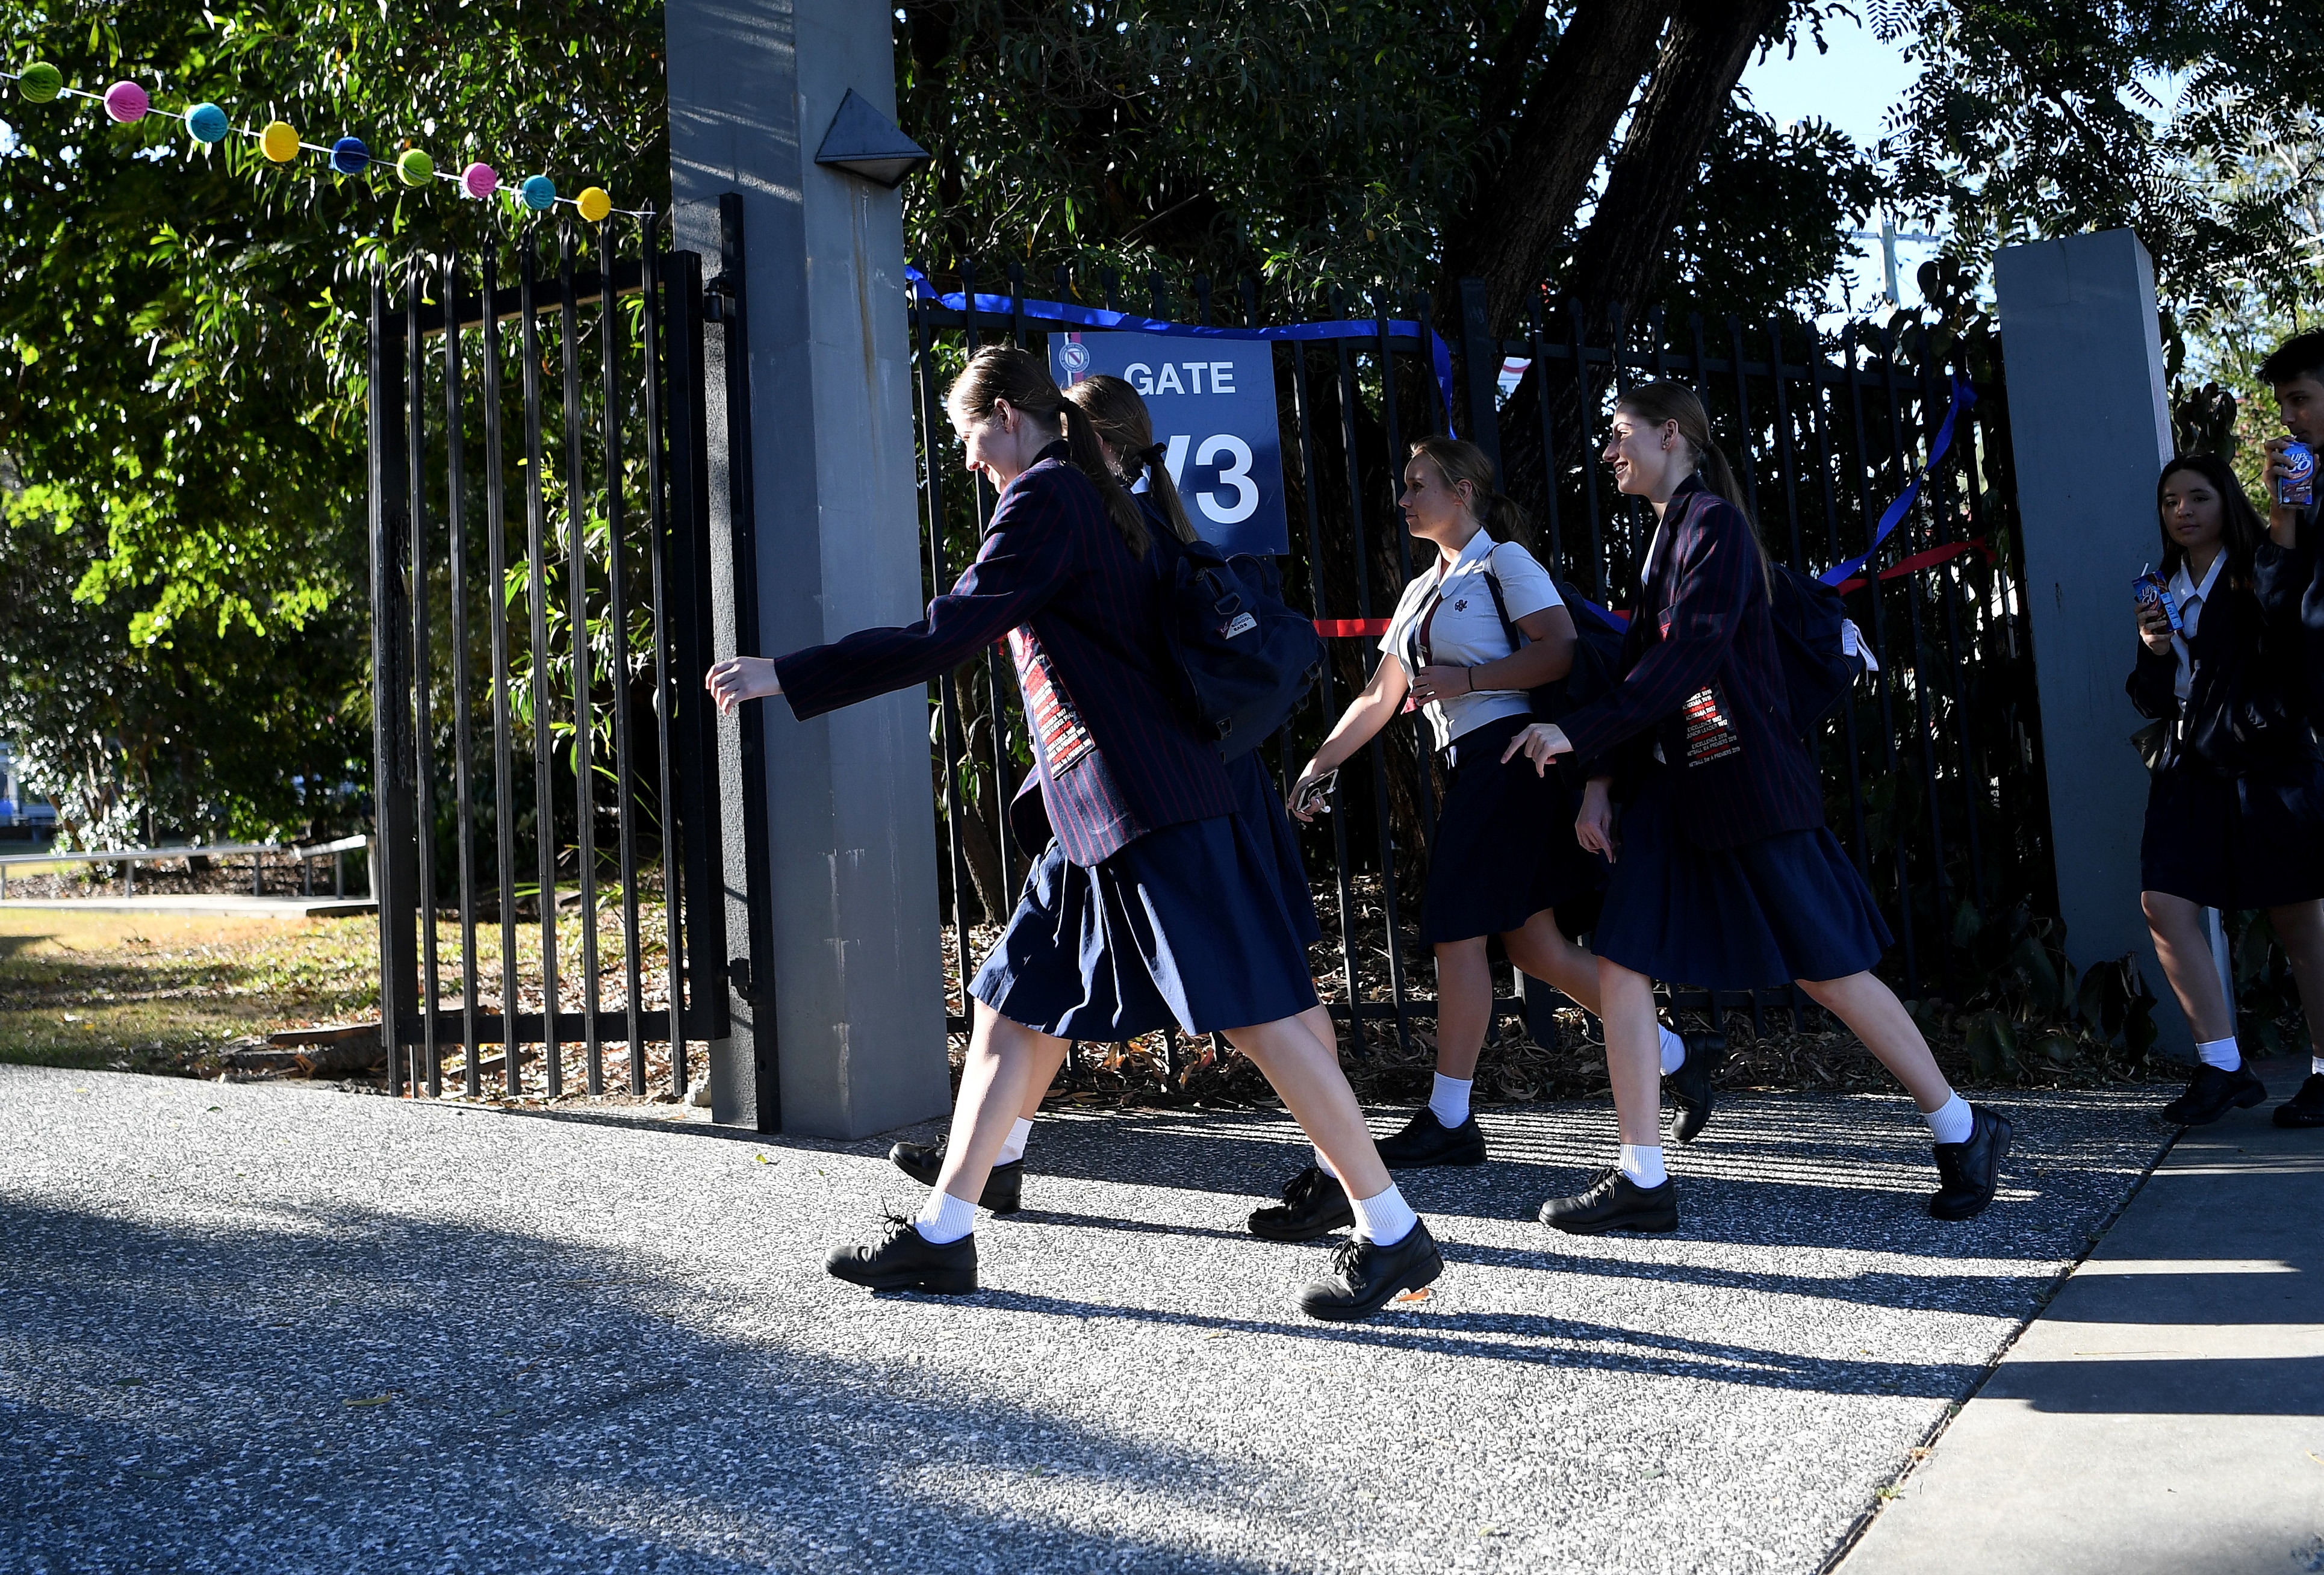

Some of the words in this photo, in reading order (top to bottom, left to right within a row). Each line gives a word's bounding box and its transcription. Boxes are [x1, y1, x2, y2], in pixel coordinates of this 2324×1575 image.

[1124, 361, 1236, 396] GATE
[1231, 617, 1252, 628] SCHOOL
[1686, 729, 1701, 739] JUNIOR
[1702, 723, 1718, 733] LEADER
[1687, 719, 1712, 733] EXCELLENCE
[1692, 736, 1718, 750] EXCELLENCE
